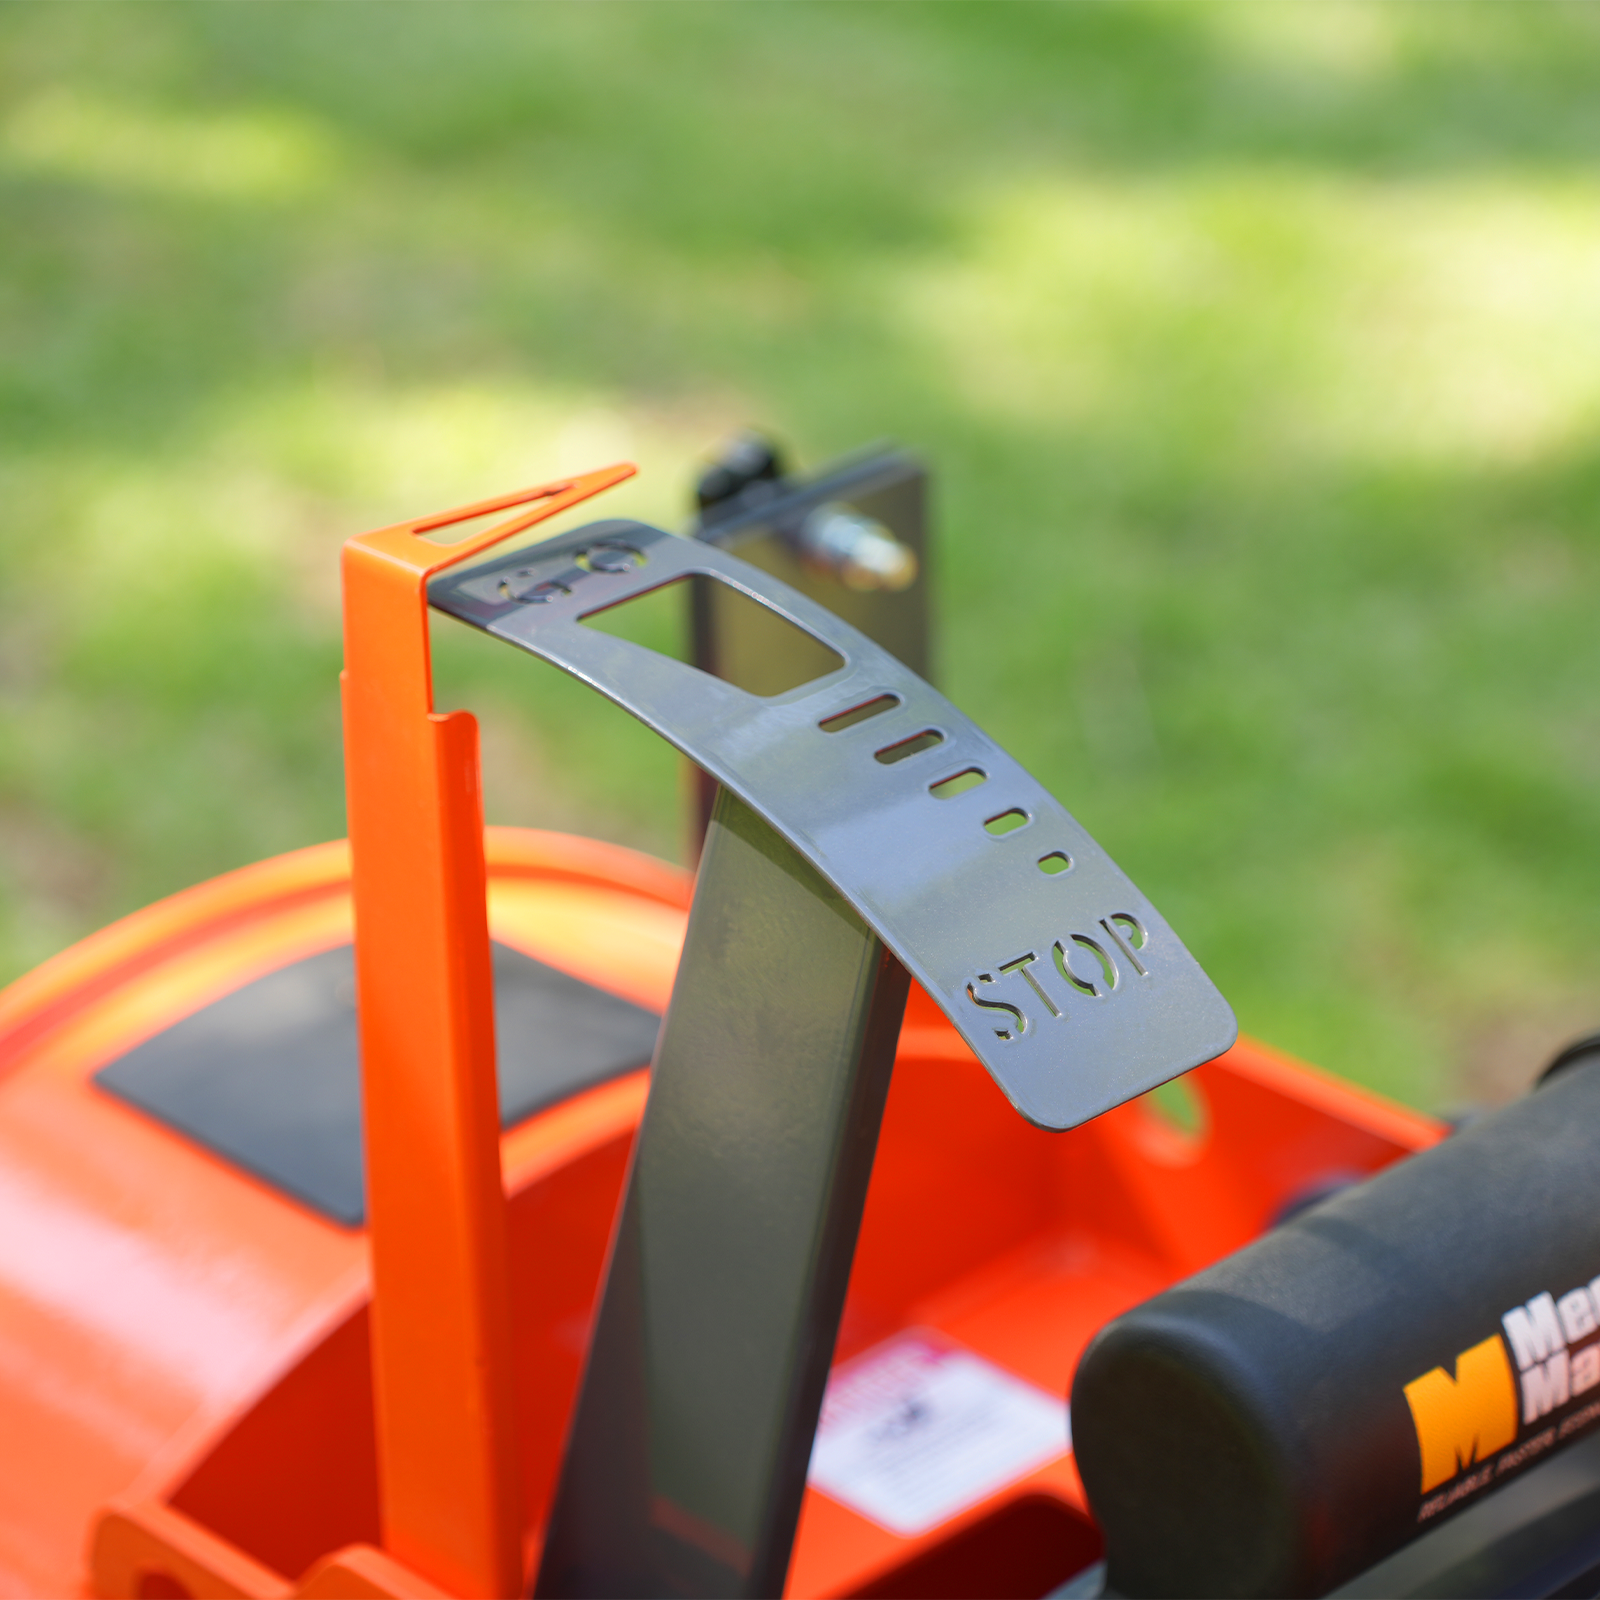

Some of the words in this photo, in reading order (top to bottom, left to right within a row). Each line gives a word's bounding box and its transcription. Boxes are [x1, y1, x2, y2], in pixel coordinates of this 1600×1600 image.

[497, 538, 649, 605] GO
[966, 911, 1148, 1041] STOP
[1403, 1332, 1518, 1496] M
